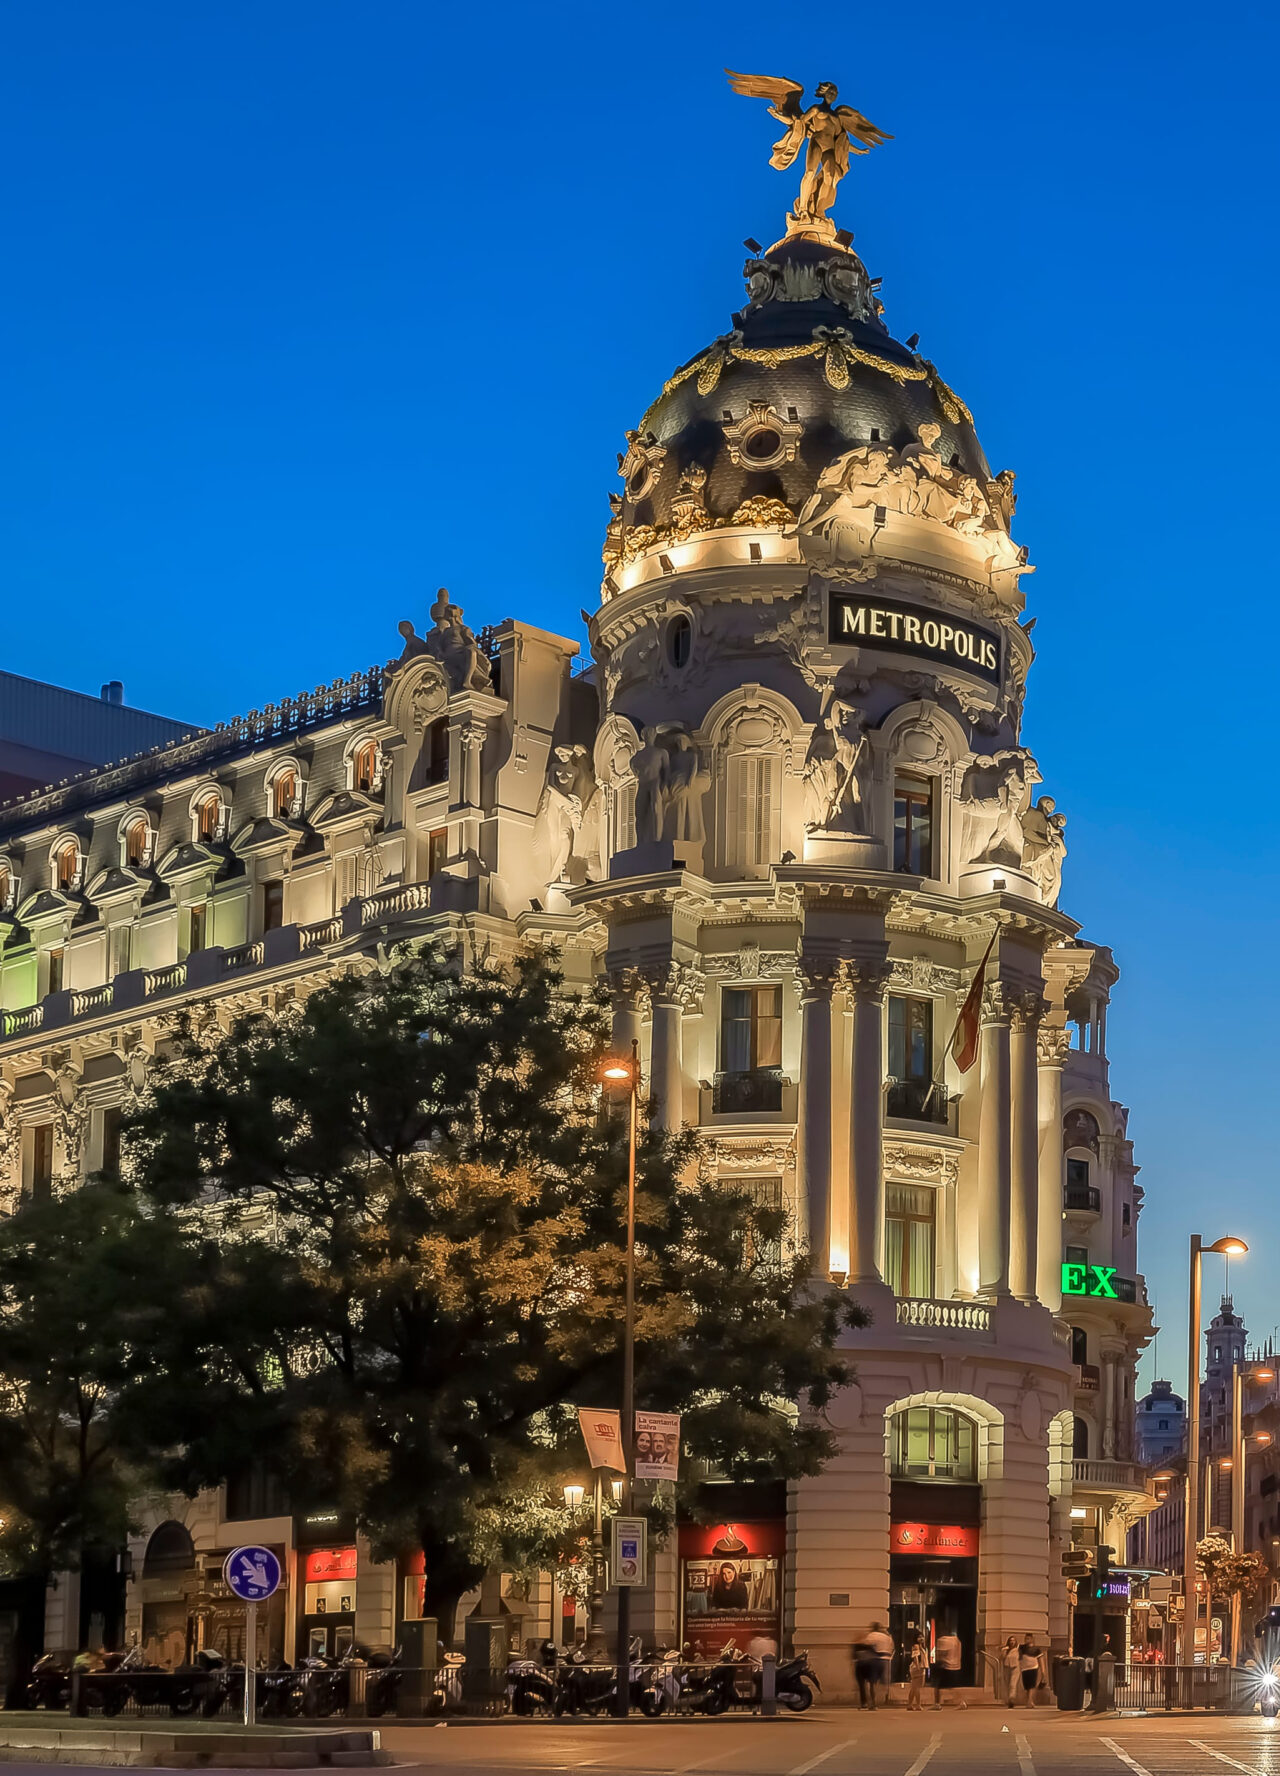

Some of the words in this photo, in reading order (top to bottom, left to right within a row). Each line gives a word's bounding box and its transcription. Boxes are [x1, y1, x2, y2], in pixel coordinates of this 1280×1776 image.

[842, 606, 996, 670] METROPOLIS
[638, 1416, 647, 1424] La
[649, 1418, 678, 1427] cantante
